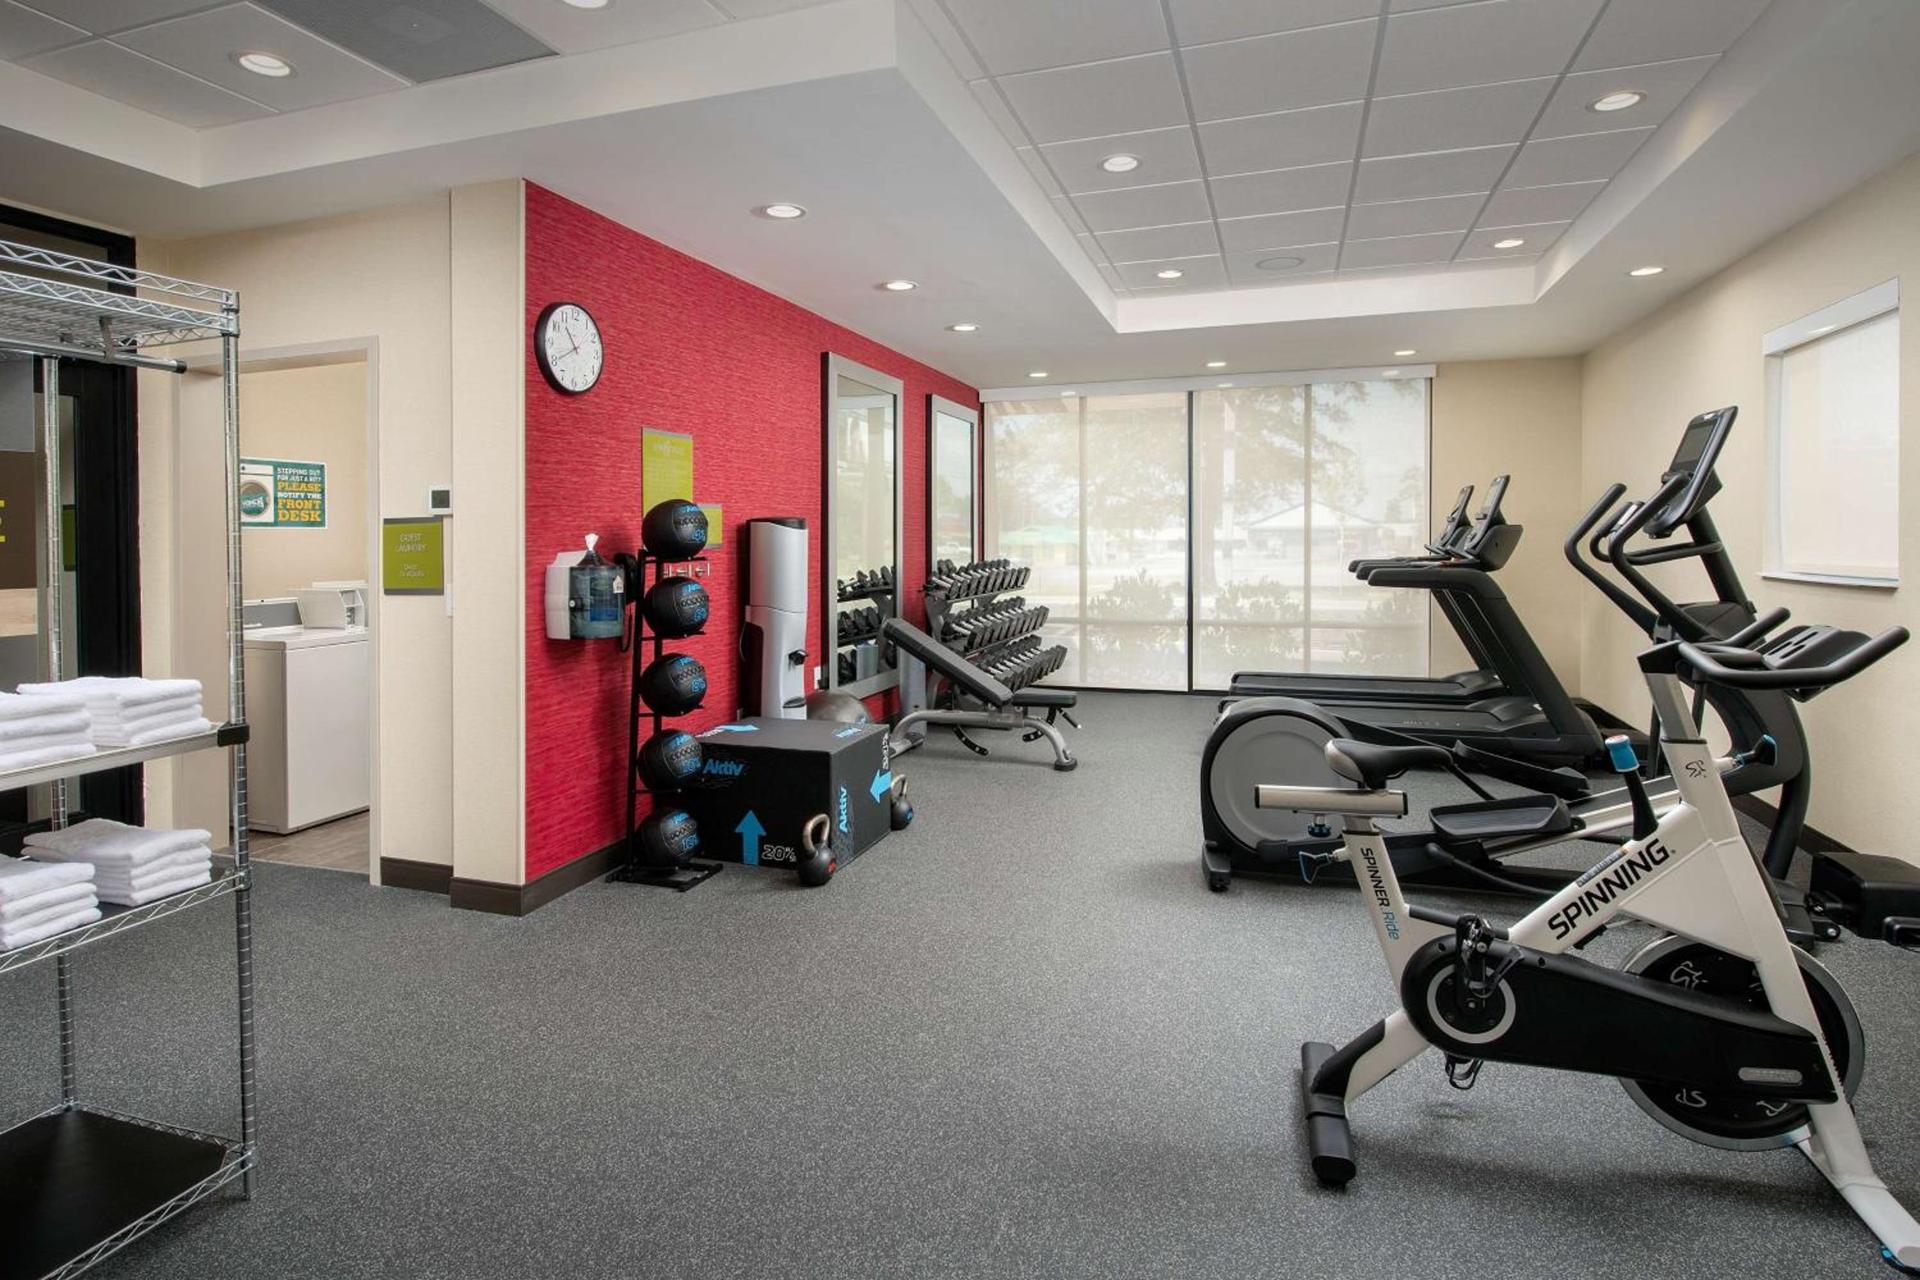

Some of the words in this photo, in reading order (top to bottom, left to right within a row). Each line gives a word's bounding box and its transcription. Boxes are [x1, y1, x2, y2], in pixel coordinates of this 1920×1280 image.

[561, 311, 568, 324] 11
[571, 309, 580, 322] 12
[590, 332, 597, 344] 2
[551, 354, 558, 367] 8
[277, 467, 308, 476] STEPPING
[277, 481, 322, 492] PLEASE
[277, 499, 322, 510] FRONT
[278, 510, 322, 522] DESK
[702, 758, 745, 777] Aktiv
[839, 785, 848, 833] Aktiv
[1360, 847, 1391, 908] SPINNER
[1382, 911, 1401, 941] Ride
[1547, 838, 1671, 940] SPINNING
